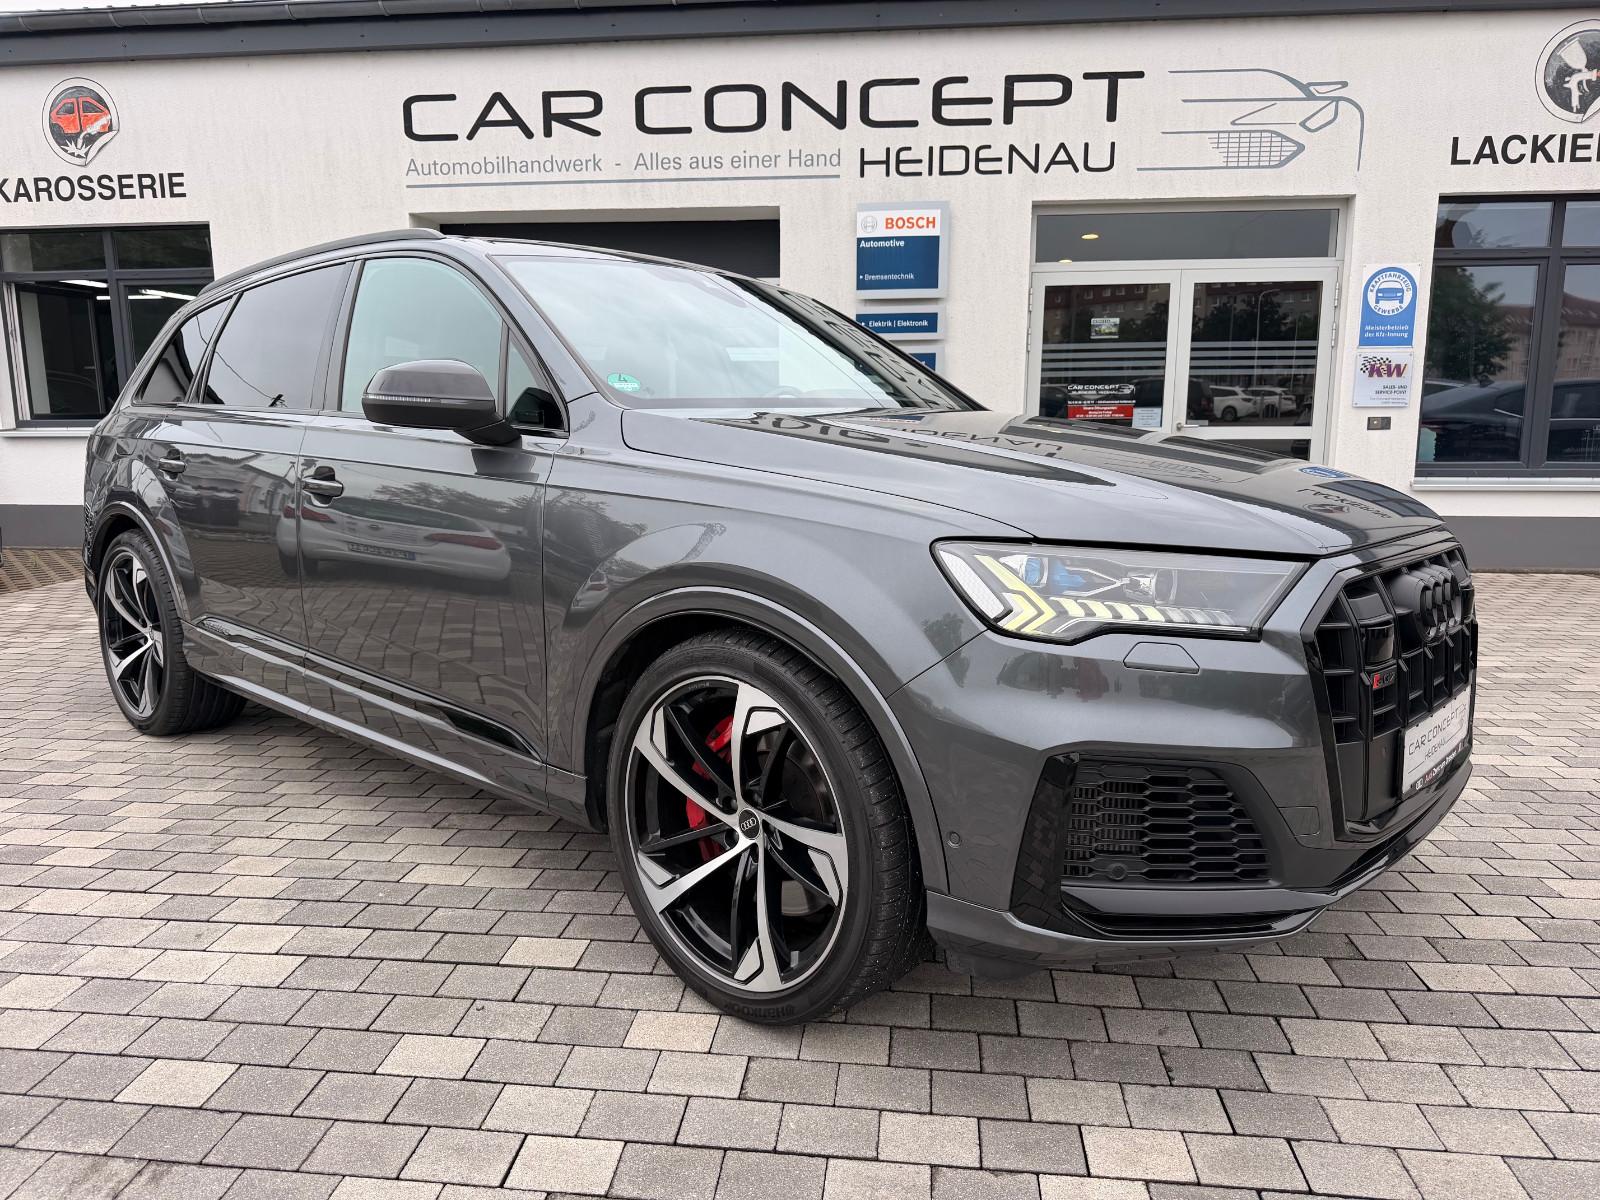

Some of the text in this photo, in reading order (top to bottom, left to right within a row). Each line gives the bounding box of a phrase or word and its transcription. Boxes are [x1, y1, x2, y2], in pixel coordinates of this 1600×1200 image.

[402, 70, 1145, 142] CAR CONCEPT
[860, 140, 1116, 178] HEIDENAU
[1450, 133, 1600, 166] LACKIE
[406, 153, 602, 177] Automobilhandwerk
[634, 151, 682, 171] Alles
[689, 154, 724, 170] aus
[730, 150, 780, 170] einer
[788, 147, 841, 168] Hand
[885, 216, 936, 230] BOSCH
[860, 238, 905, 248] Automotive
[864, 273, 914, 281] Bremsentechnik
[1370, 272, 1411, 293] KRAFTFAHRZEUG
[1373, 304, 1404, 315] GEWERBE
[868, 320, 893, 328] Elektrik
[897, 318, 929, 327] Elektronik
[1408, 734, 1426, 756] CAR
